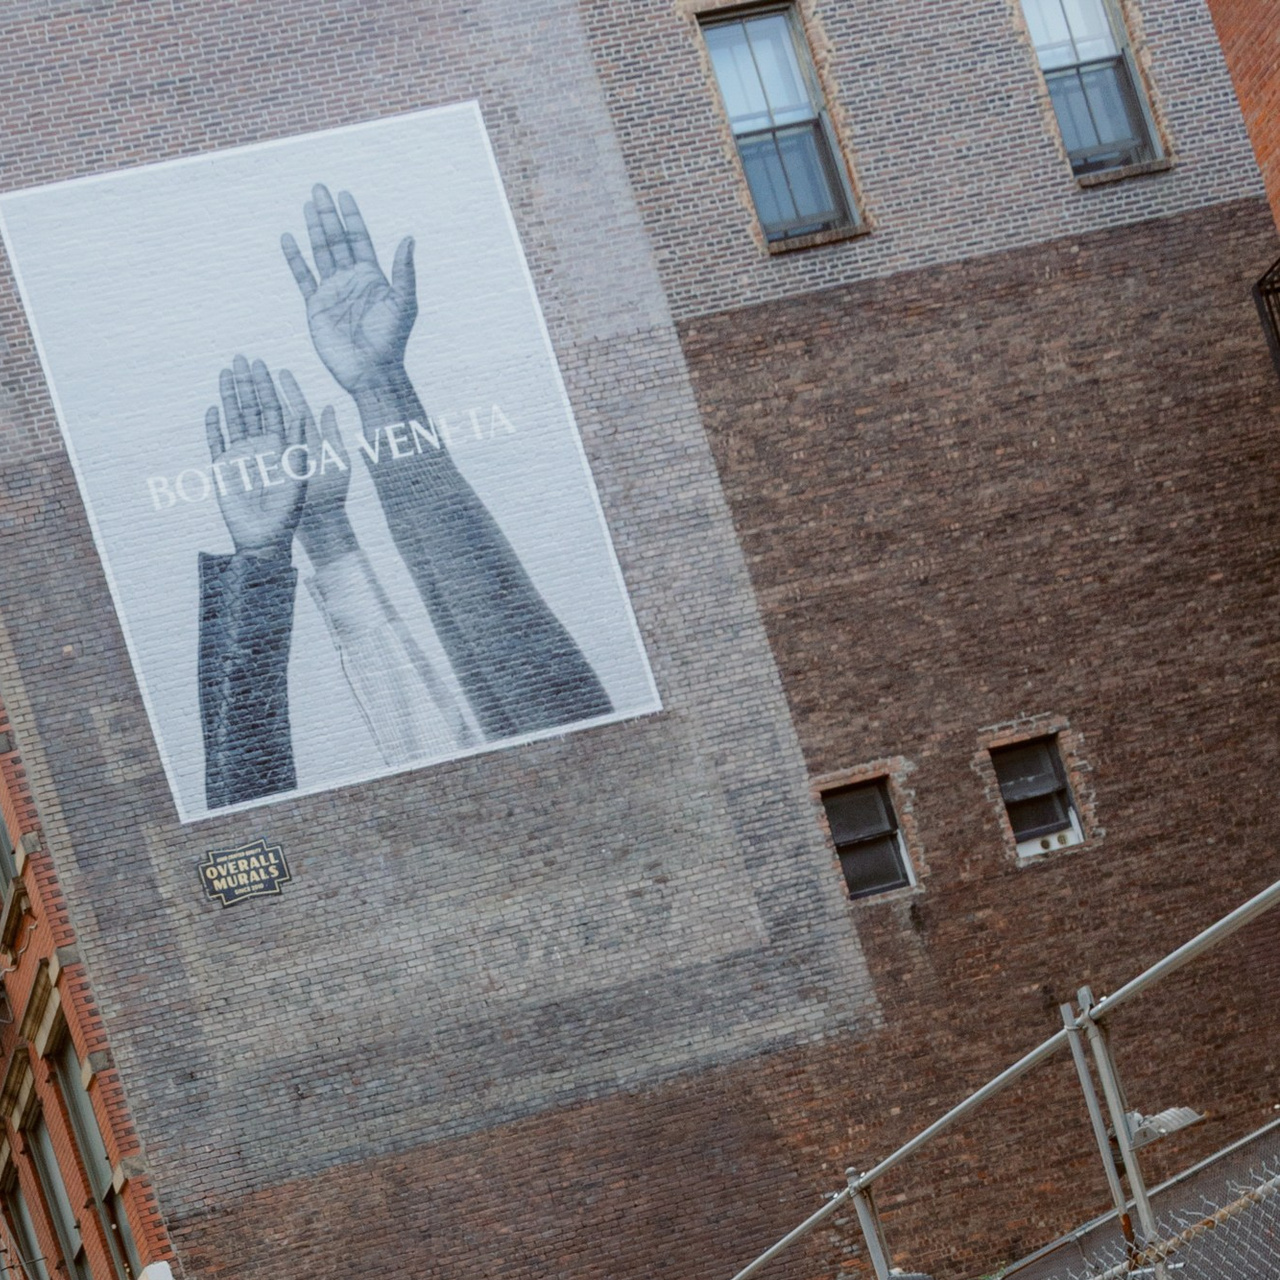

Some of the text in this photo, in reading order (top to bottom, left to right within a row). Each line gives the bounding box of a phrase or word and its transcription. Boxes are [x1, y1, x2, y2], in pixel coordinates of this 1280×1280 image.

[146, 403, 517, 512] BOTTEGA VENETA
[206, 852, 279, 879] OVERALL
[213, 865, 279, 892] MURALS
